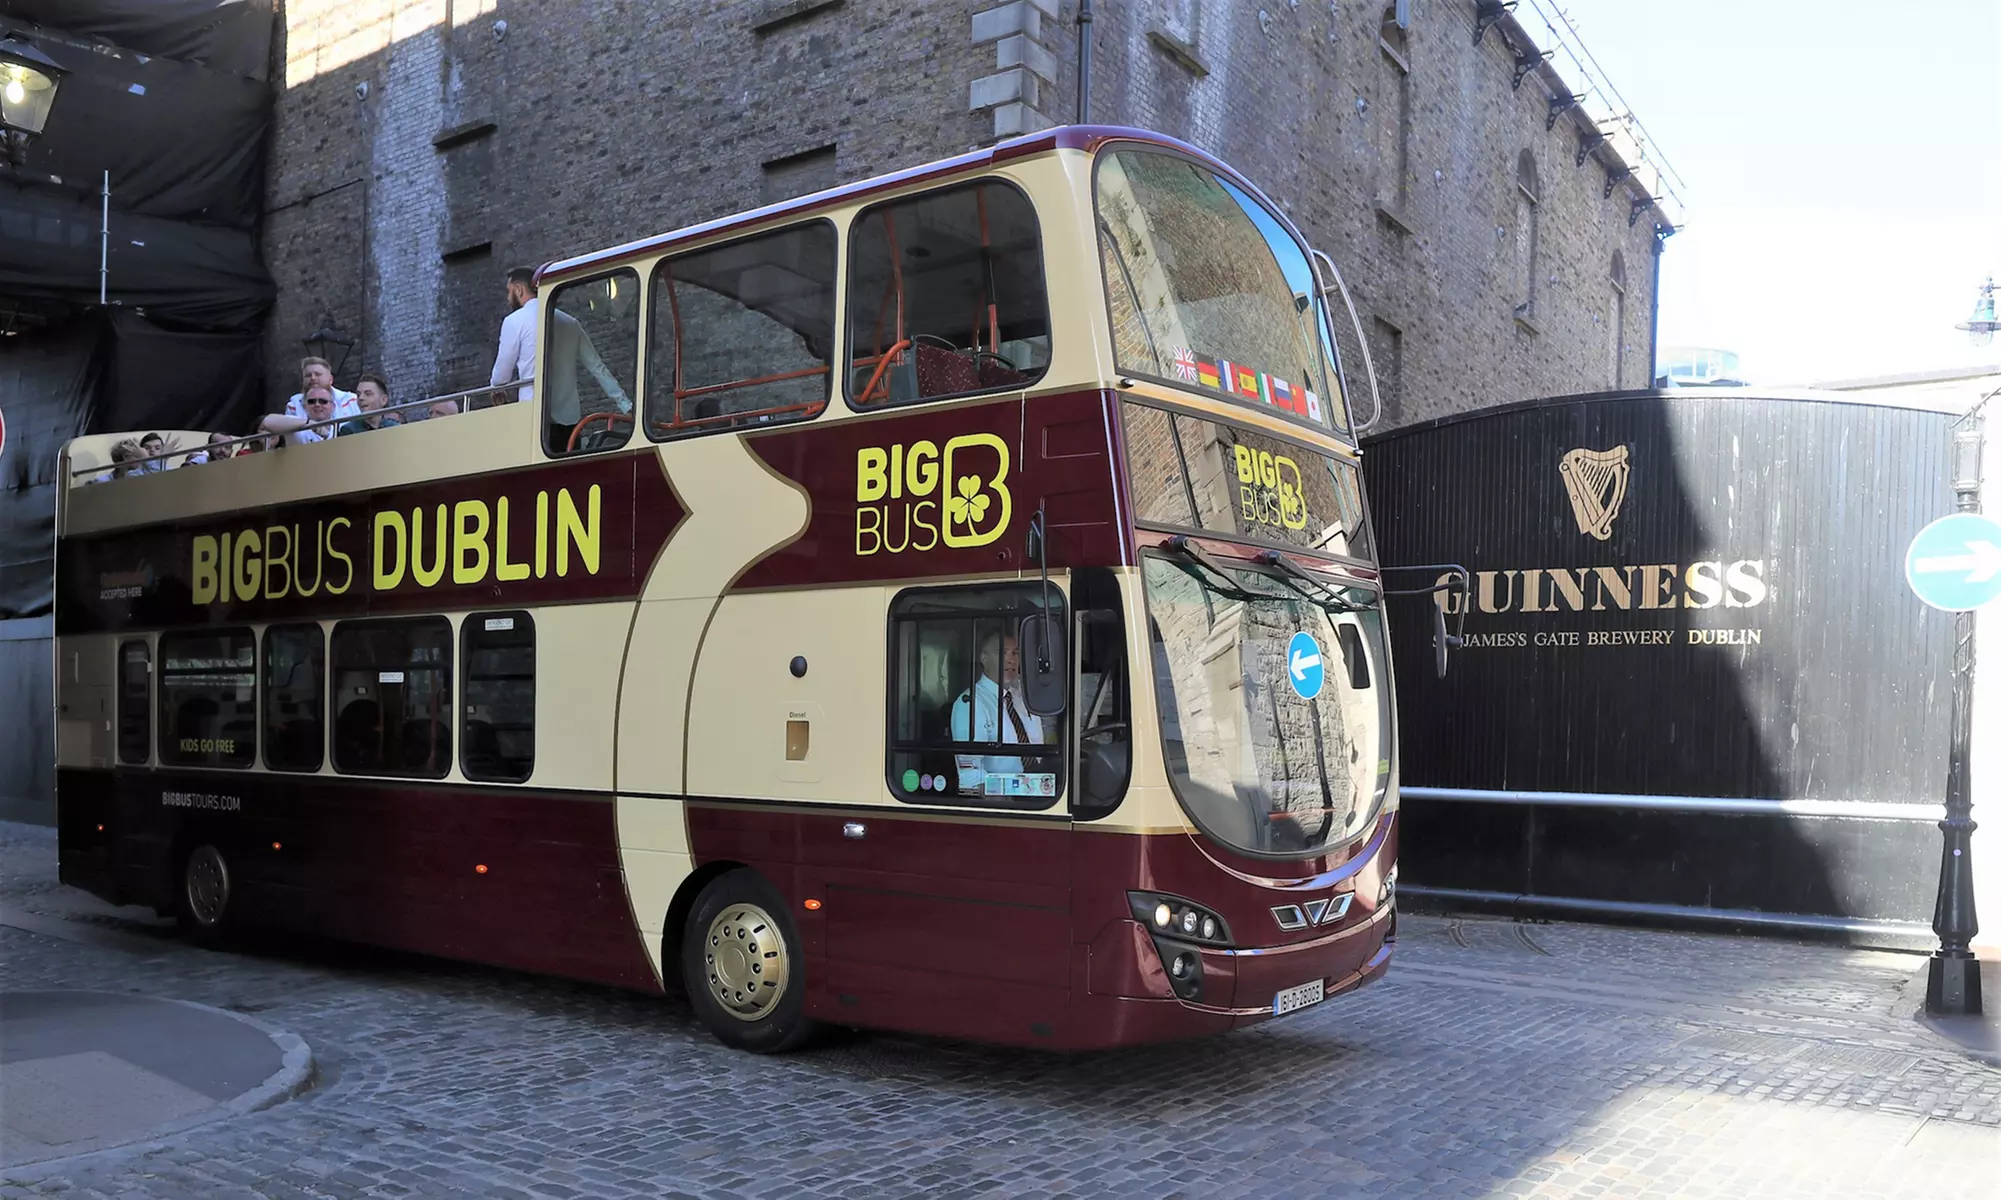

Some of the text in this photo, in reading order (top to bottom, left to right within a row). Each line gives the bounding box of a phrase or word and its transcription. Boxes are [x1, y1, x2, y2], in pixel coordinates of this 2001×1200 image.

[856, 439, 940, 503] BIG
[1233, 444, 1277, 489] BIG
[1240, 486, 1282, 526] BUS
[372, 484, 602, 591] DUBLIN
[855, 500, 939, 556] BUS
[101, 587, 142, 599] ACCEPTED HERE
[1433, 559, 1767, 615] GUINNESS
[1534, 632, 1580, 647] GATE
[1587, 630, 1676, 646] BREWERY
[1687, 629, 1762, 646] DUBLIN
[789, 711, 807, 719] Diesel
[180, 739, 235, 753] KIDS GO FREE
[162, 792, 241, 811] BIGBUSTOURS.COM
